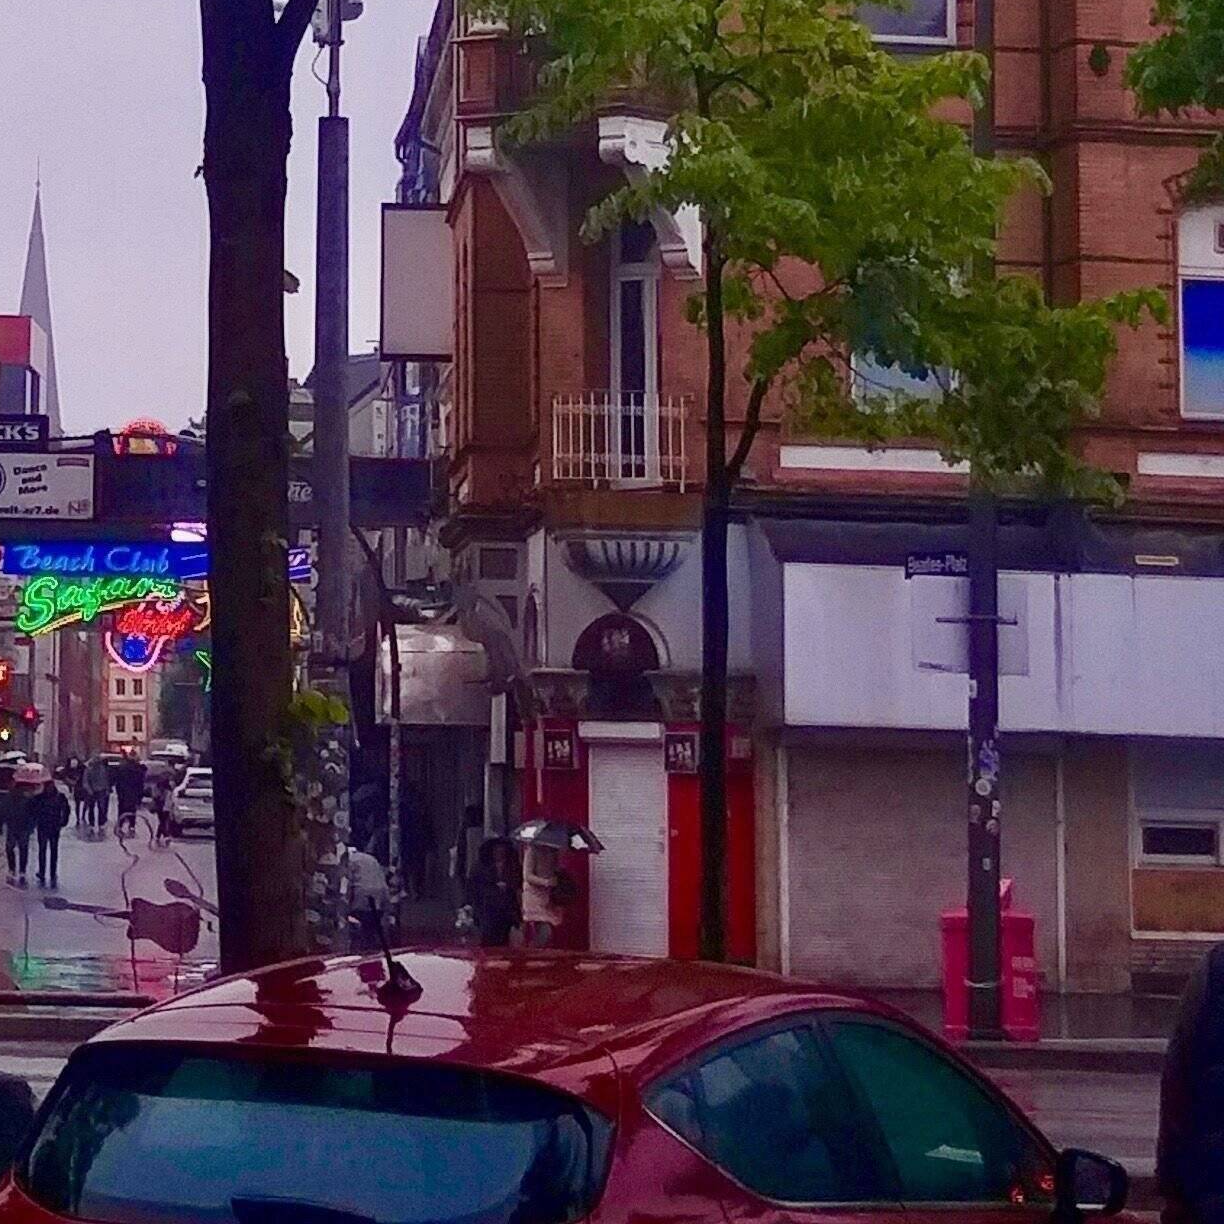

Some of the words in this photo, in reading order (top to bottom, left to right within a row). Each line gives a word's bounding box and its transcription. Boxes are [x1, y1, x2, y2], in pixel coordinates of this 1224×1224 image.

[18, 485, 48, 495] More
[12, 545, 95, 572] Beach
[104, 546, 169, 573] Club
